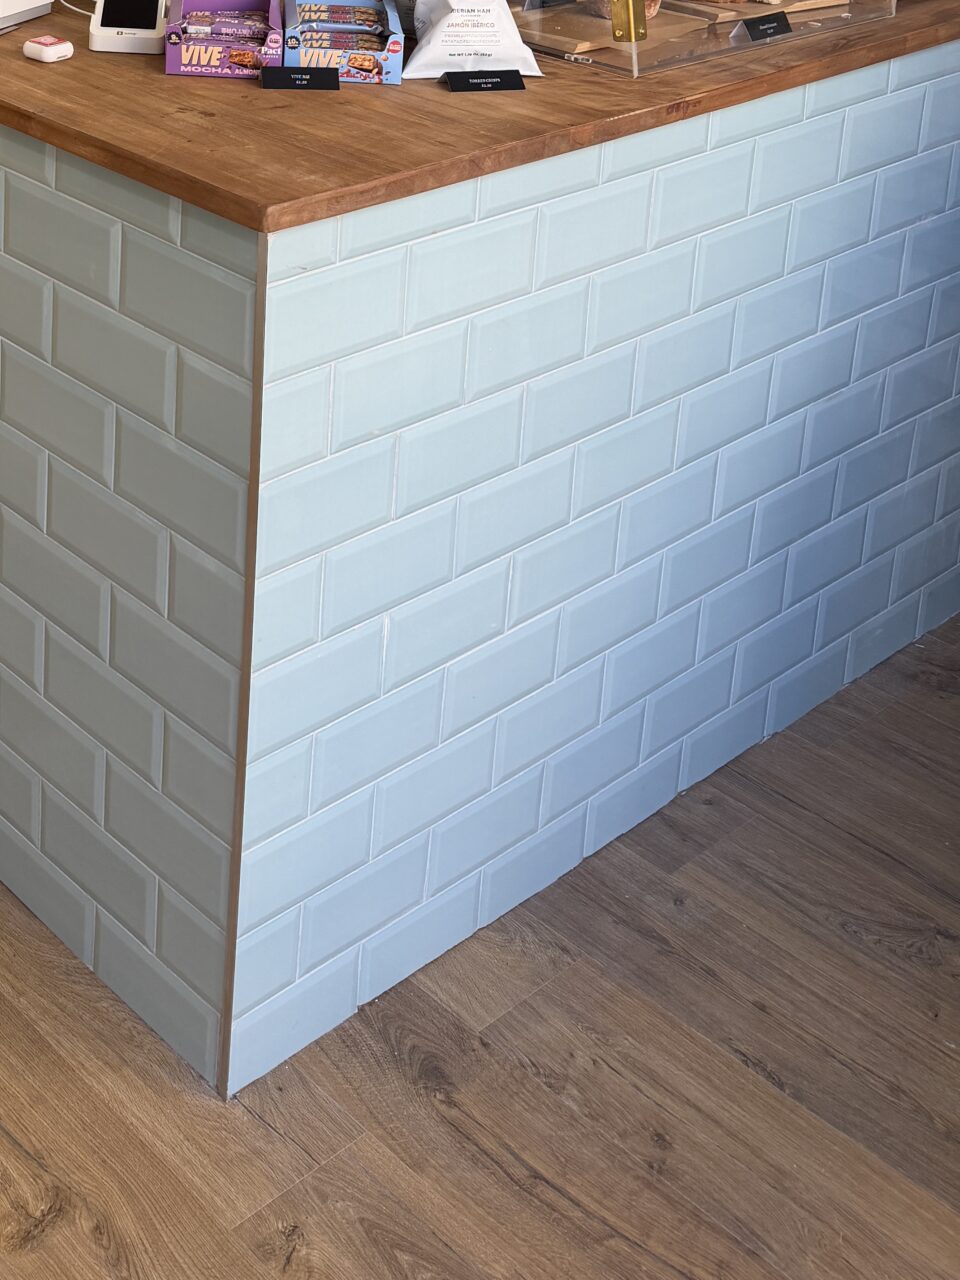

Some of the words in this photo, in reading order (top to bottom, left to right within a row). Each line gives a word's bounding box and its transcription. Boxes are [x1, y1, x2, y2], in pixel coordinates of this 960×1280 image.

[181, 45, 222, 65] VIVE
[261, 47, 282, 55] Pact
[300, 49, 341, 68] VIVE
[180, 66, 231, 74] MOCHA
